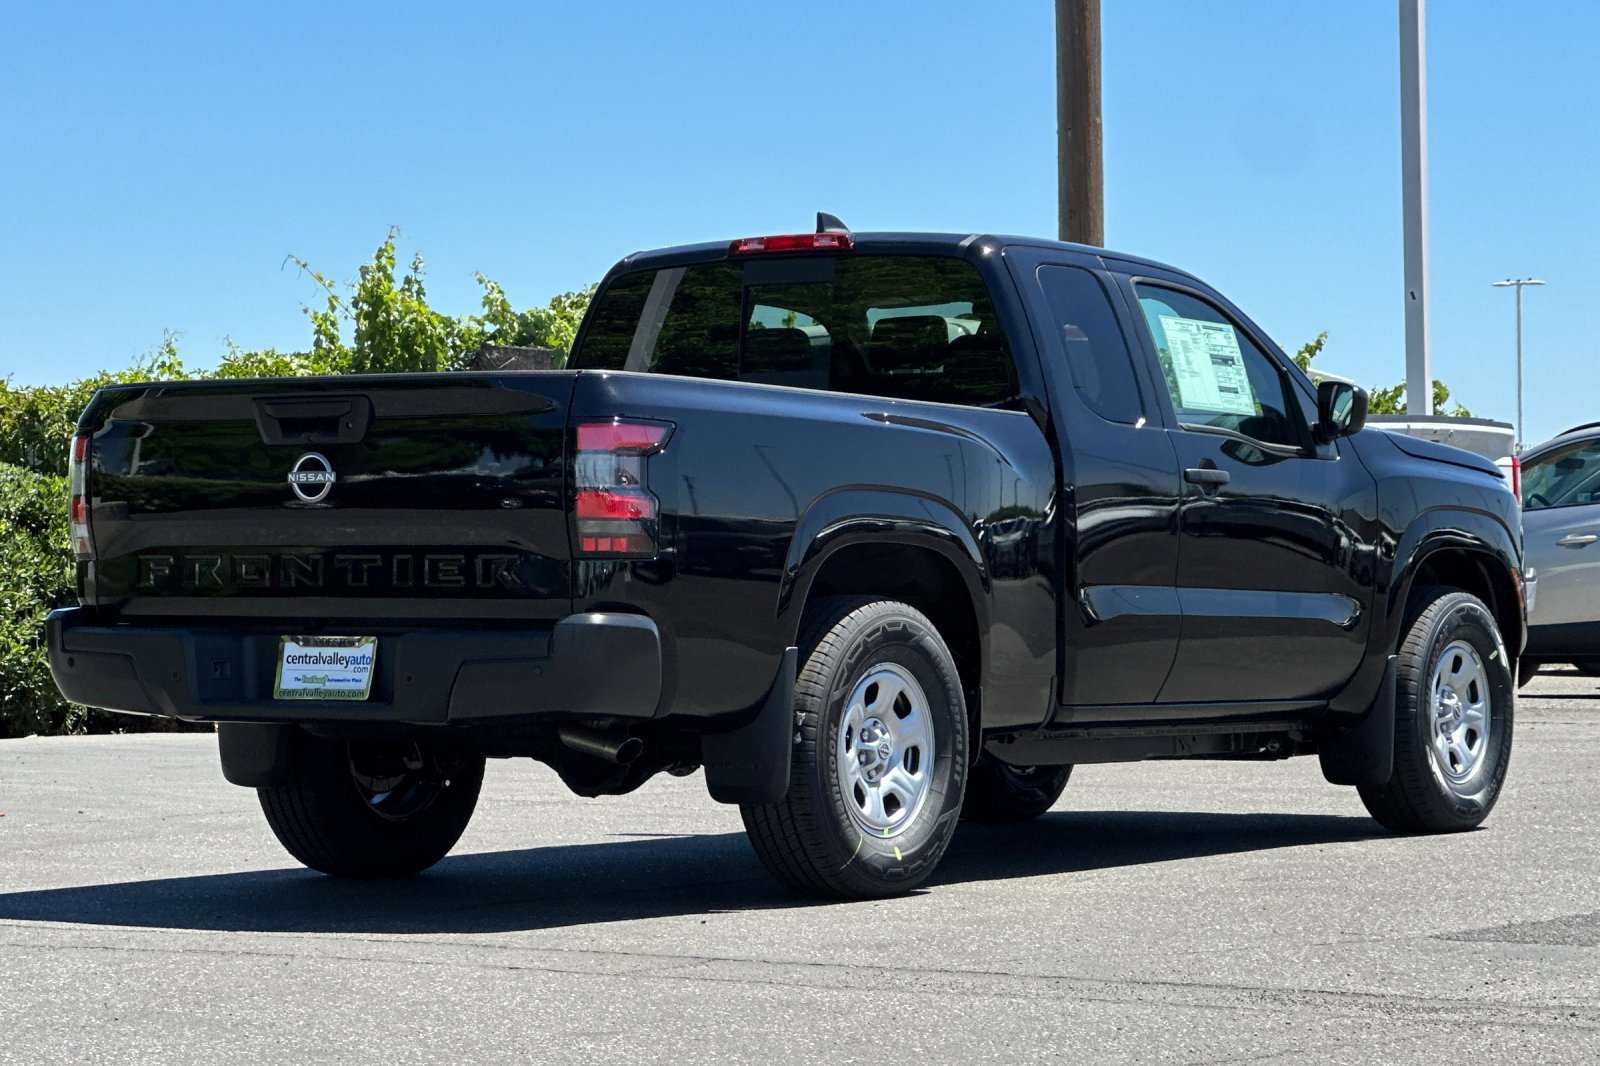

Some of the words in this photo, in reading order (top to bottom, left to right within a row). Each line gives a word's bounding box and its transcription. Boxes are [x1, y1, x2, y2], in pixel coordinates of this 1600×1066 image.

[288, 473, 334, 482] NISSAN
[137, 554, 522, 588] FRONTIER
[286, 652, 371, 668] centralvalleyauto
[279, 688, 364, 699] centralvalleyauto.com
